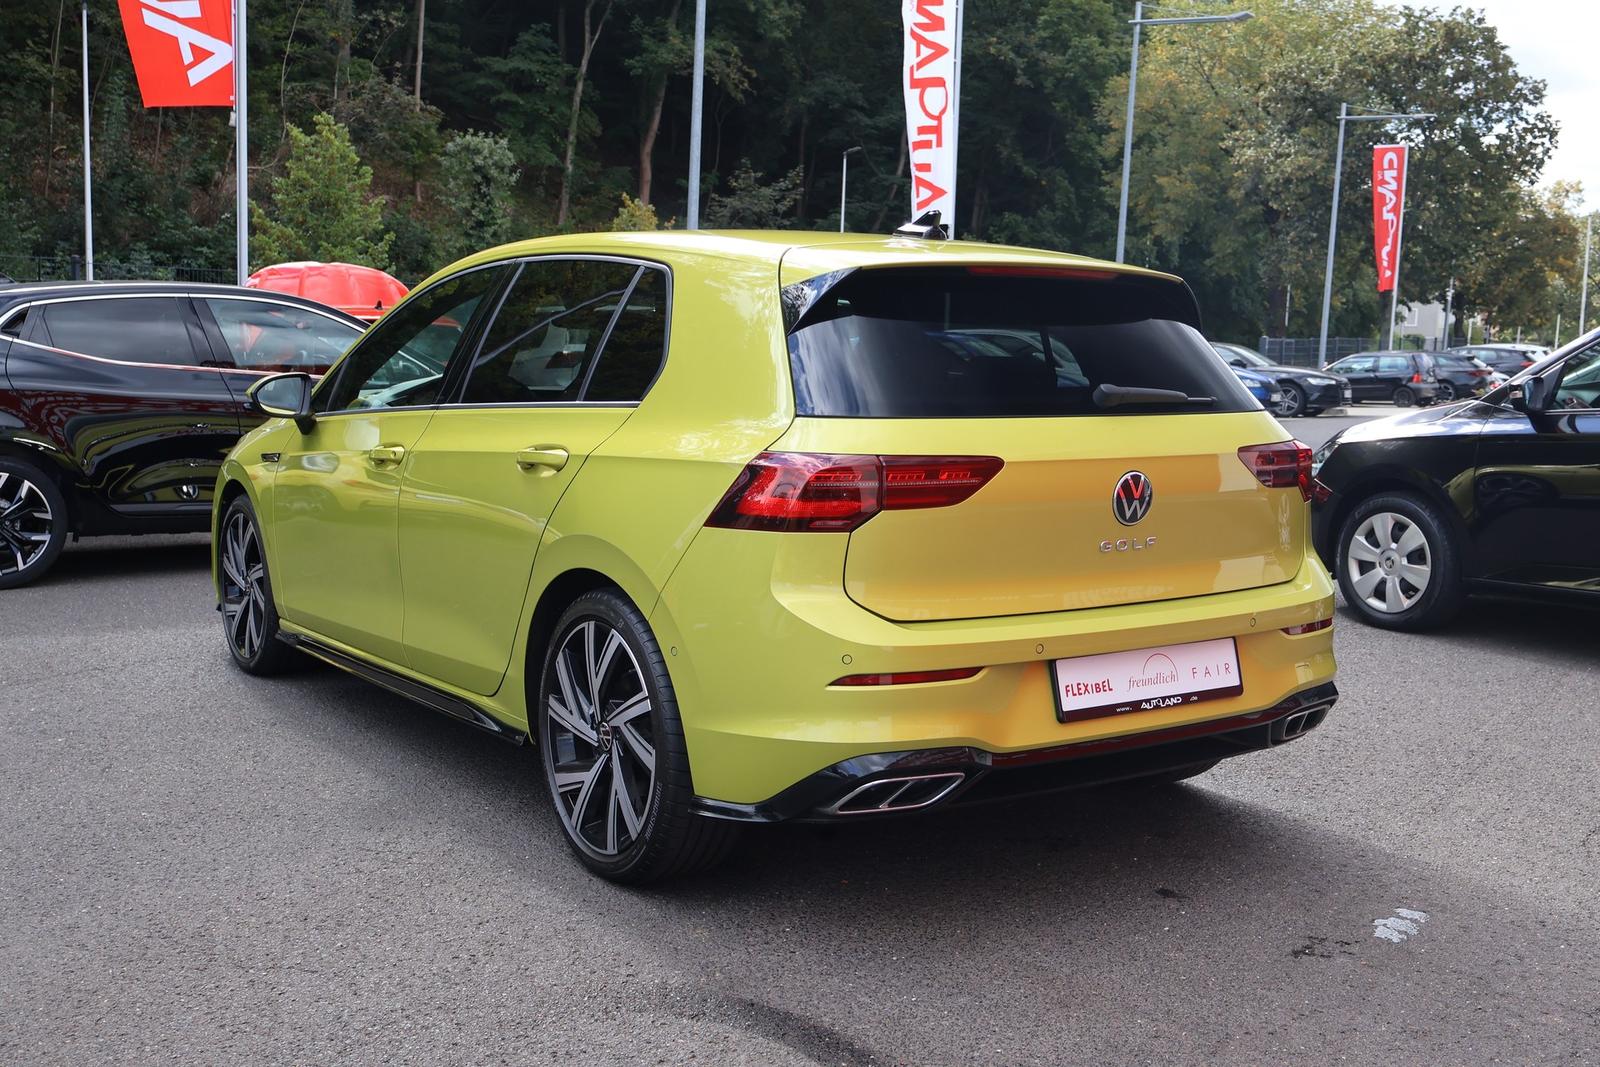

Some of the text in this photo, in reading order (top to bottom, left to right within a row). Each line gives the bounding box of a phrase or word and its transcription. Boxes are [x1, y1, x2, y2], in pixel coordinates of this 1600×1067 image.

[1100, 536, 1157, 552] GOLF
[1064, 662, 1232, 698] FLEXIBEL freundlich FAIR
[1140, 696, 1183, 710] AUTOLAND
